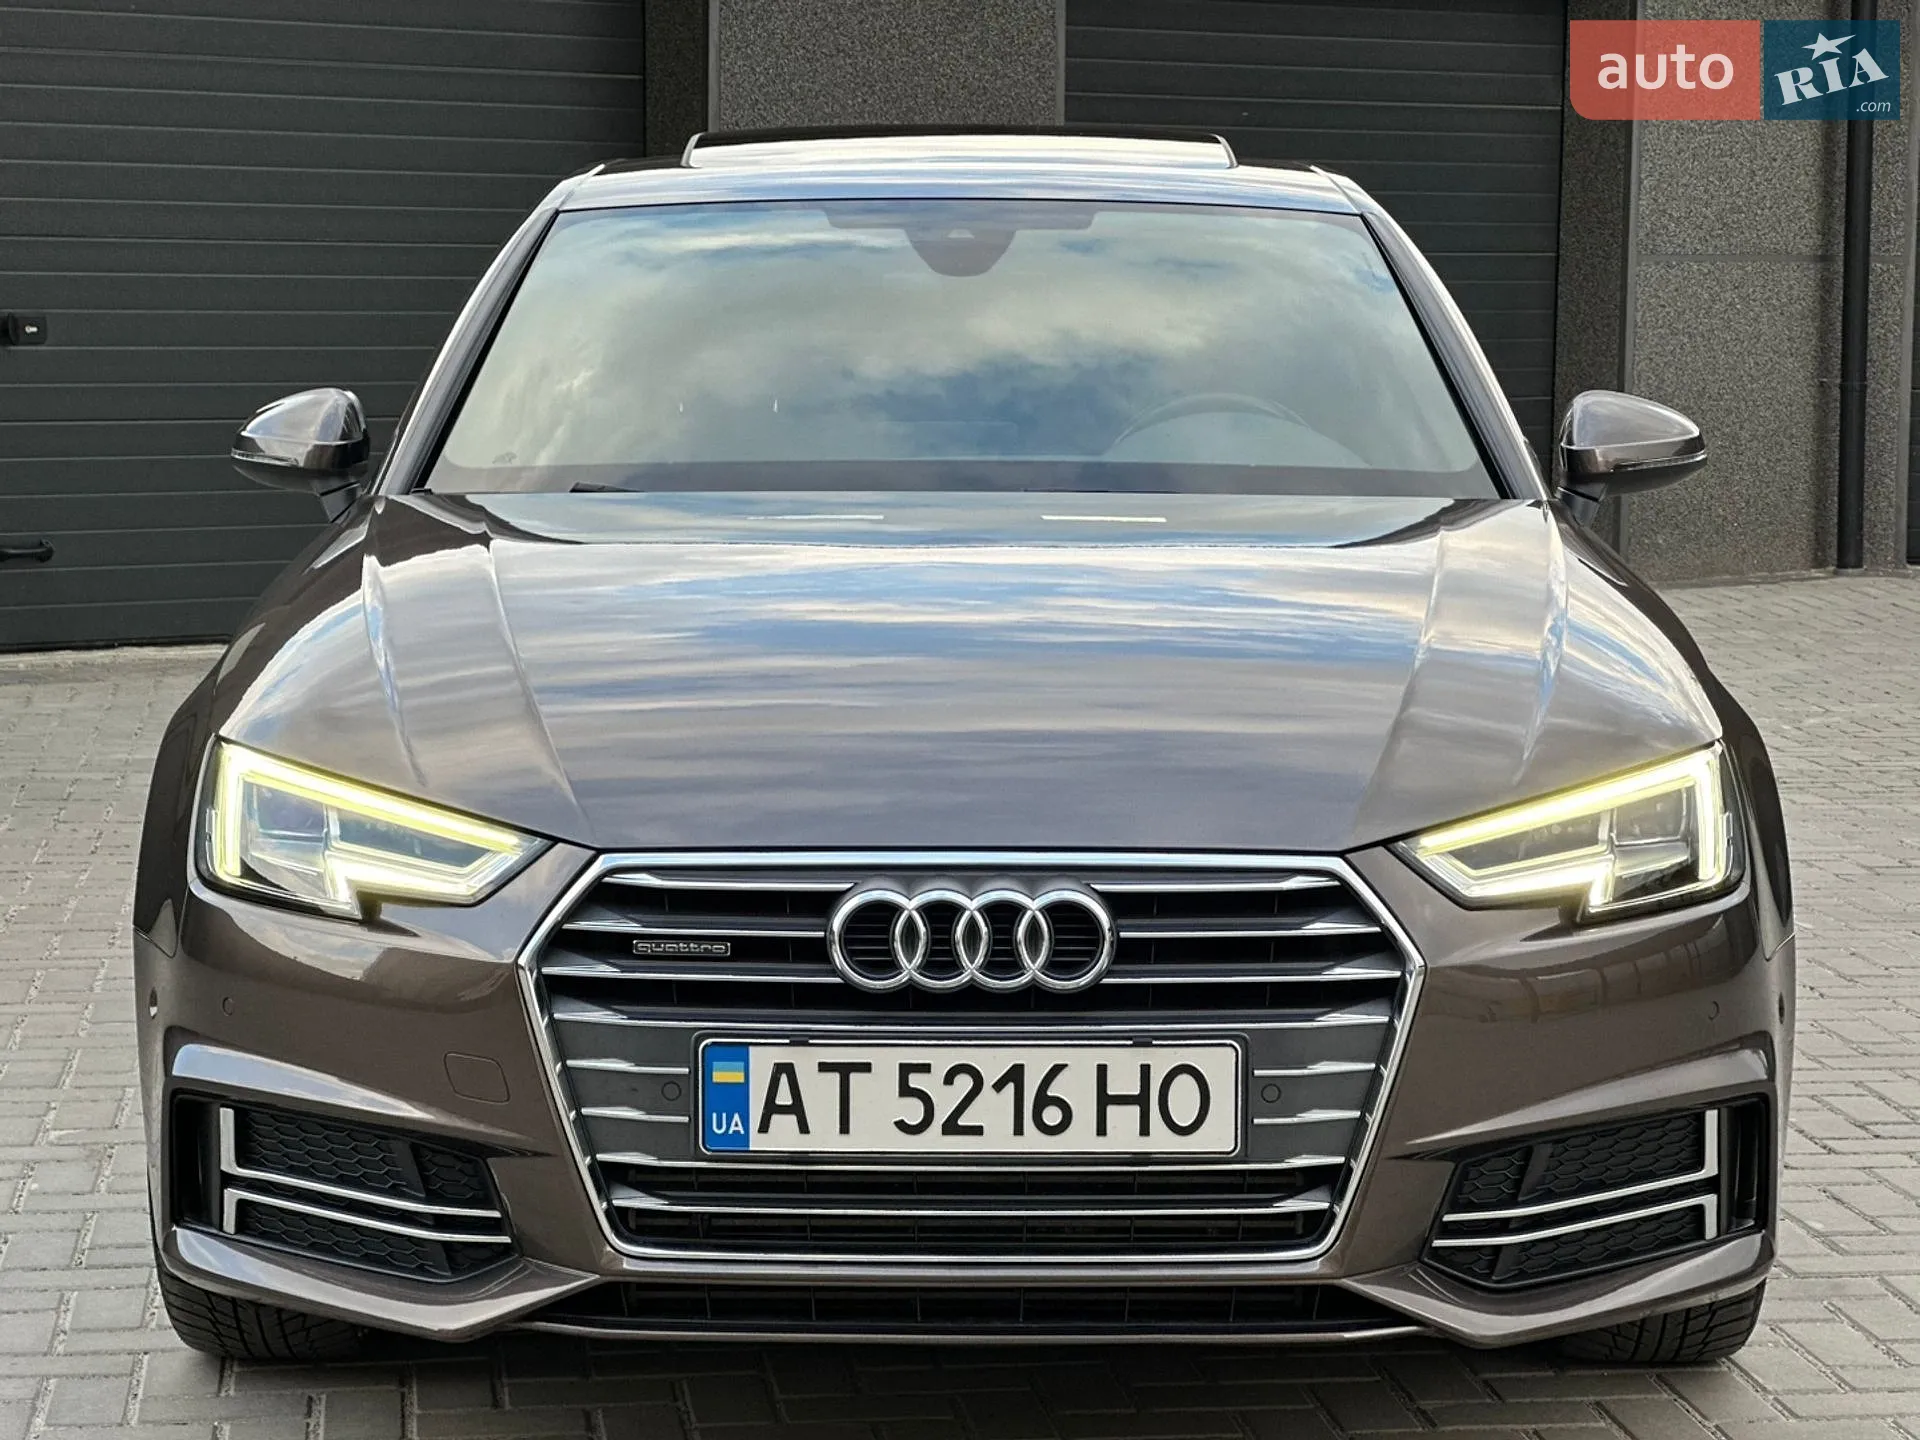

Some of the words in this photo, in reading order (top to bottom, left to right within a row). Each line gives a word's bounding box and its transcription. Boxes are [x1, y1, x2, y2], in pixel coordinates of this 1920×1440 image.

[637, 942, 726, 953] quattro
[757, 1062, 872, 1135] AT
[893, 1062, 1073, 1136] 5216
[1096, 1063, 1211, 1137] HO
[711, 1111, 744, 1134] UA
